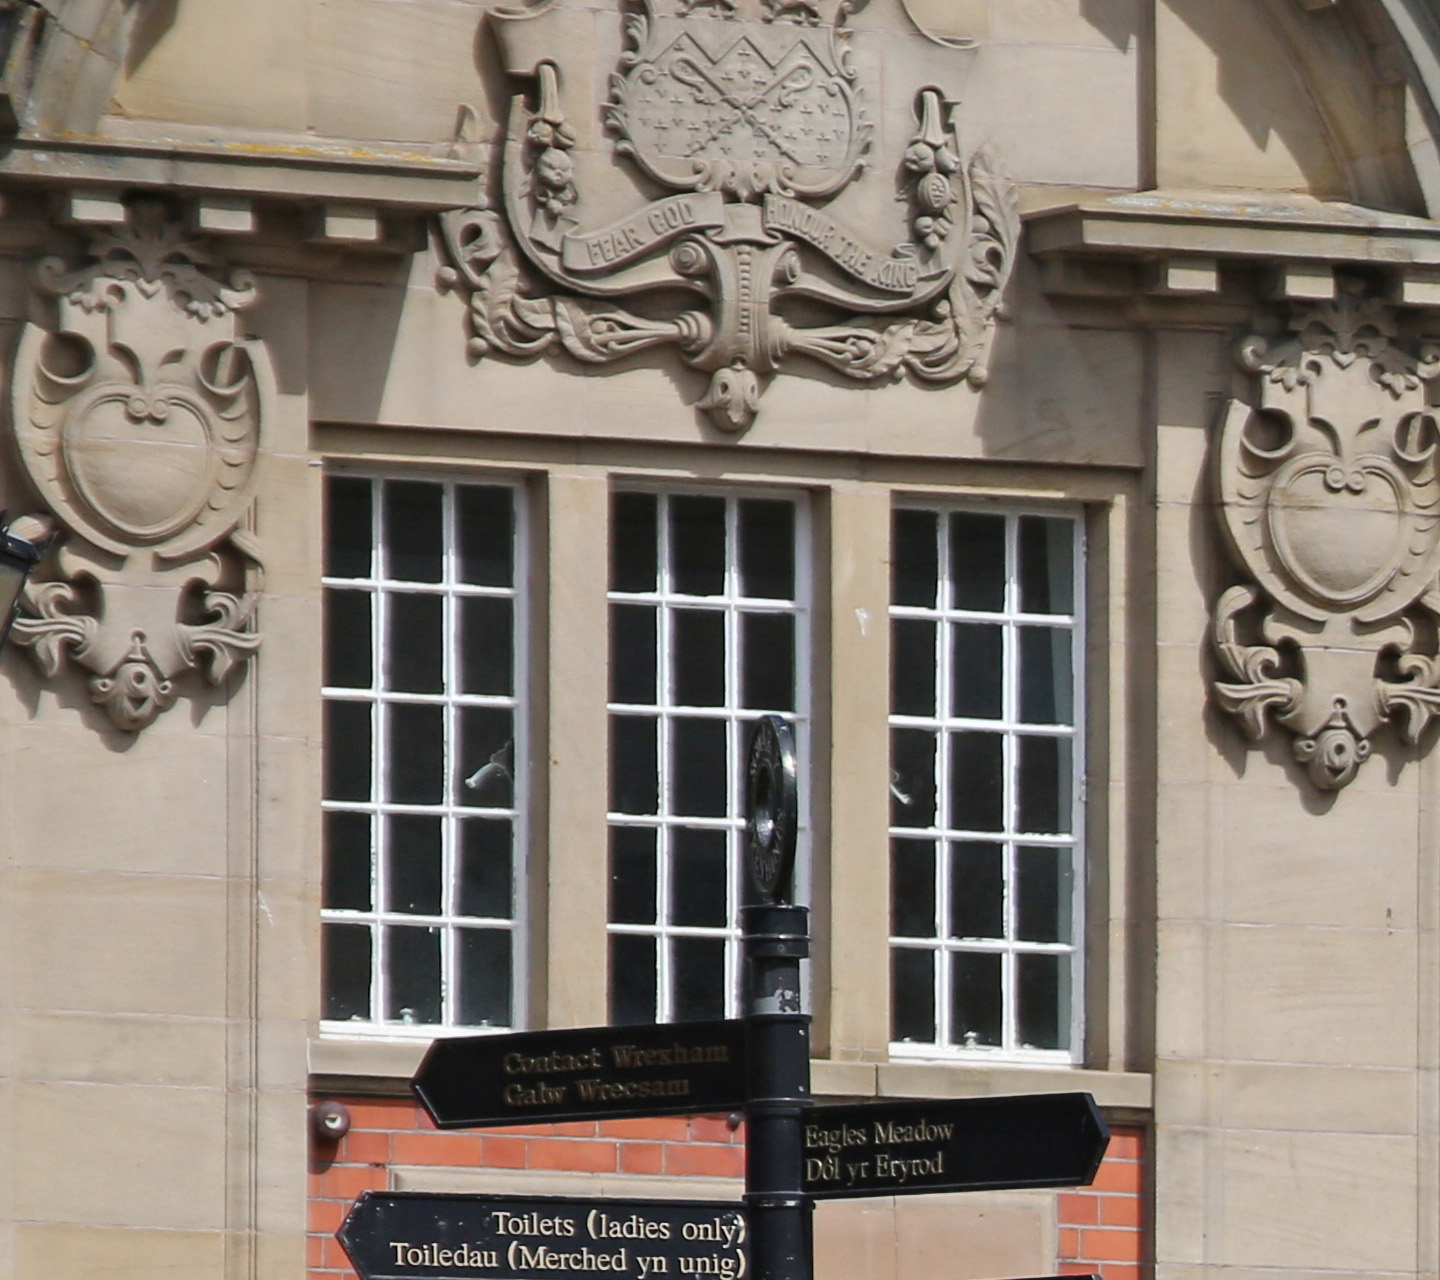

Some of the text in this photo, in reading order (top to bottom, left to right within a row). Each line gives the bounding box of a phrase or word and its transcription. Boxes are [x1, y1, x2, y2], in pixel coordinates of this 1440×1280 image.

[586, 200, 696, 267] FEAR GOD
[765, 196, 919, 289] HONOUR THE KING
[503, 1042, 730, 1076] Contact Wrexham
[503, 1077, 690, 1107] Galw Wrecsam
[805, 1119, 955, 1155] Eagles Meadow
[806, 1151, 944, 1187] Dôl yr Eryrod
[492, 1209, 746, 1249] Toilets (ladies only)
[390, 1241, 746, 1280] Toiledau (Merched yn unig)
